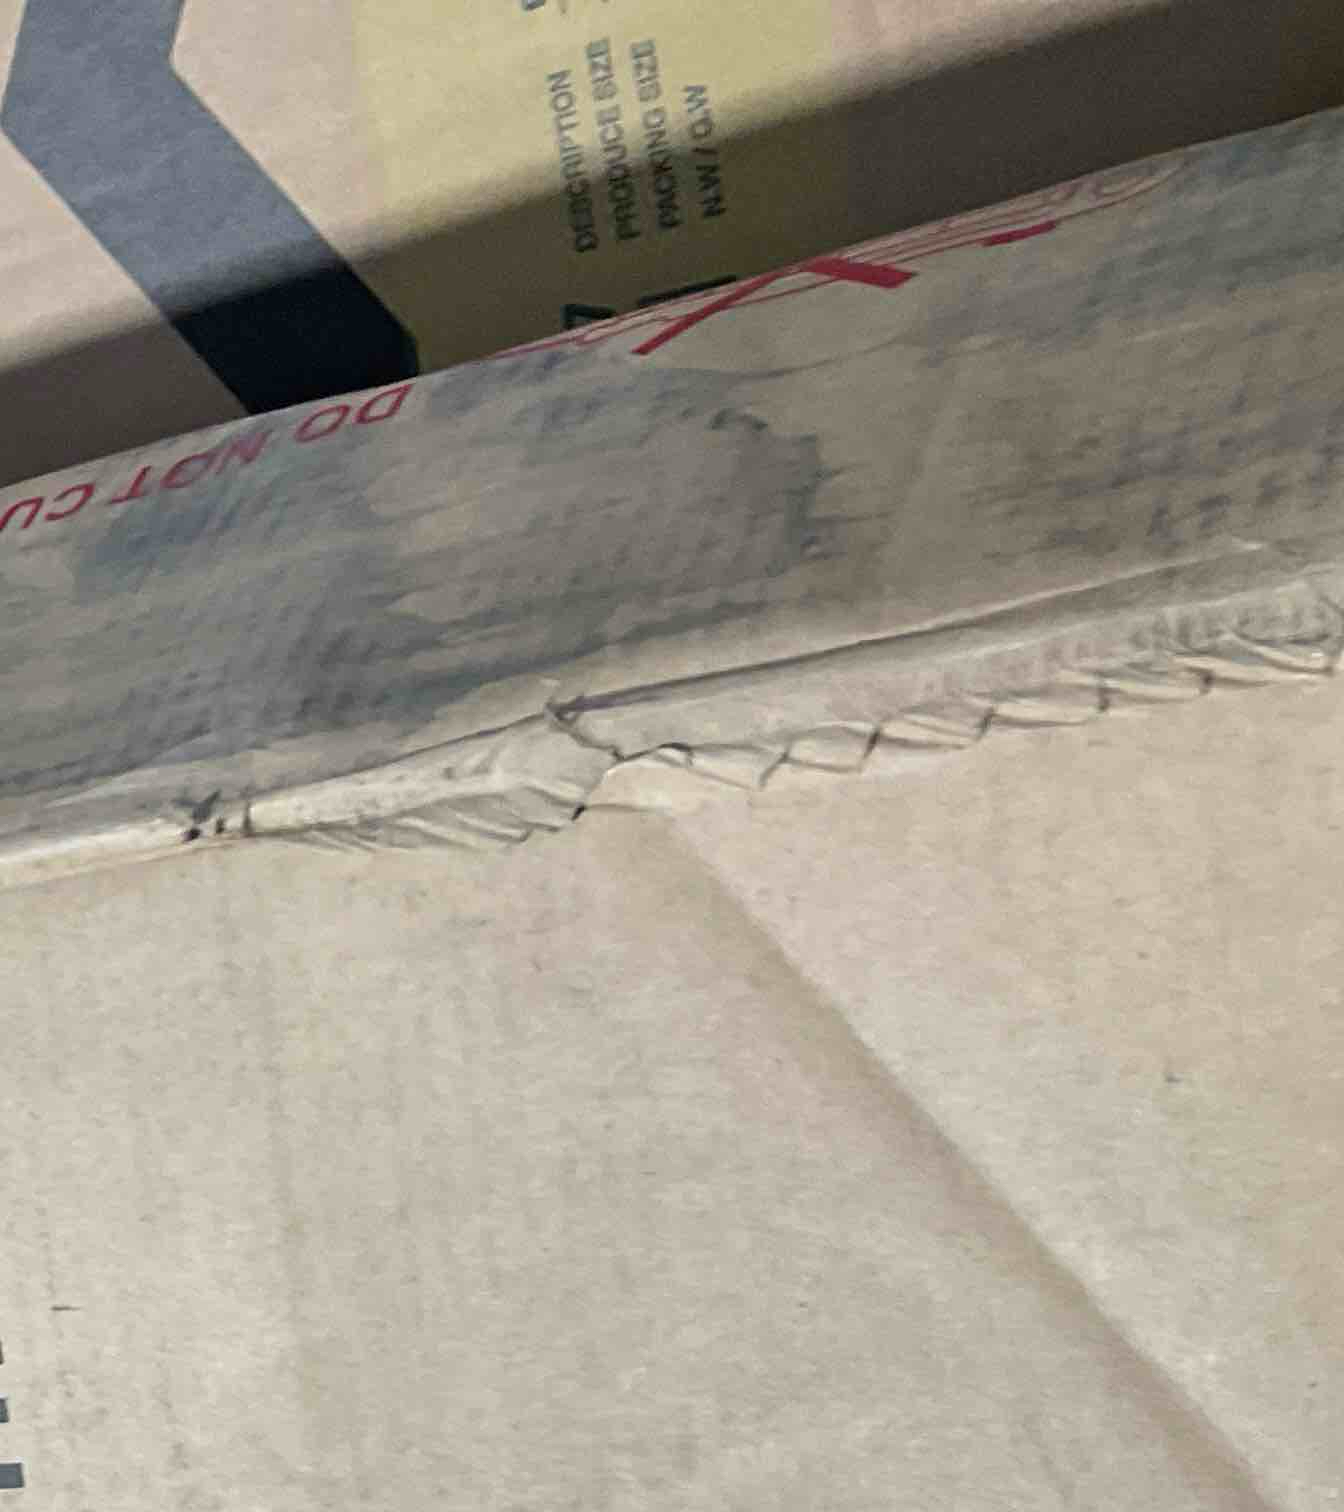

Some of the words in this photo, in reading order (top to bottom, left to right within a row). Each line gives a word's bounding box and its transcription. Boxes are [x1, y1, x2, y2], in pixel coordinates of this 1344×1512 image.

[586, 38, 616, 101] SIZE
[631, 39, 661, 102] SIZE
[293, 383, 413, 443] DO
[112, 430, 271, 504] NOT
